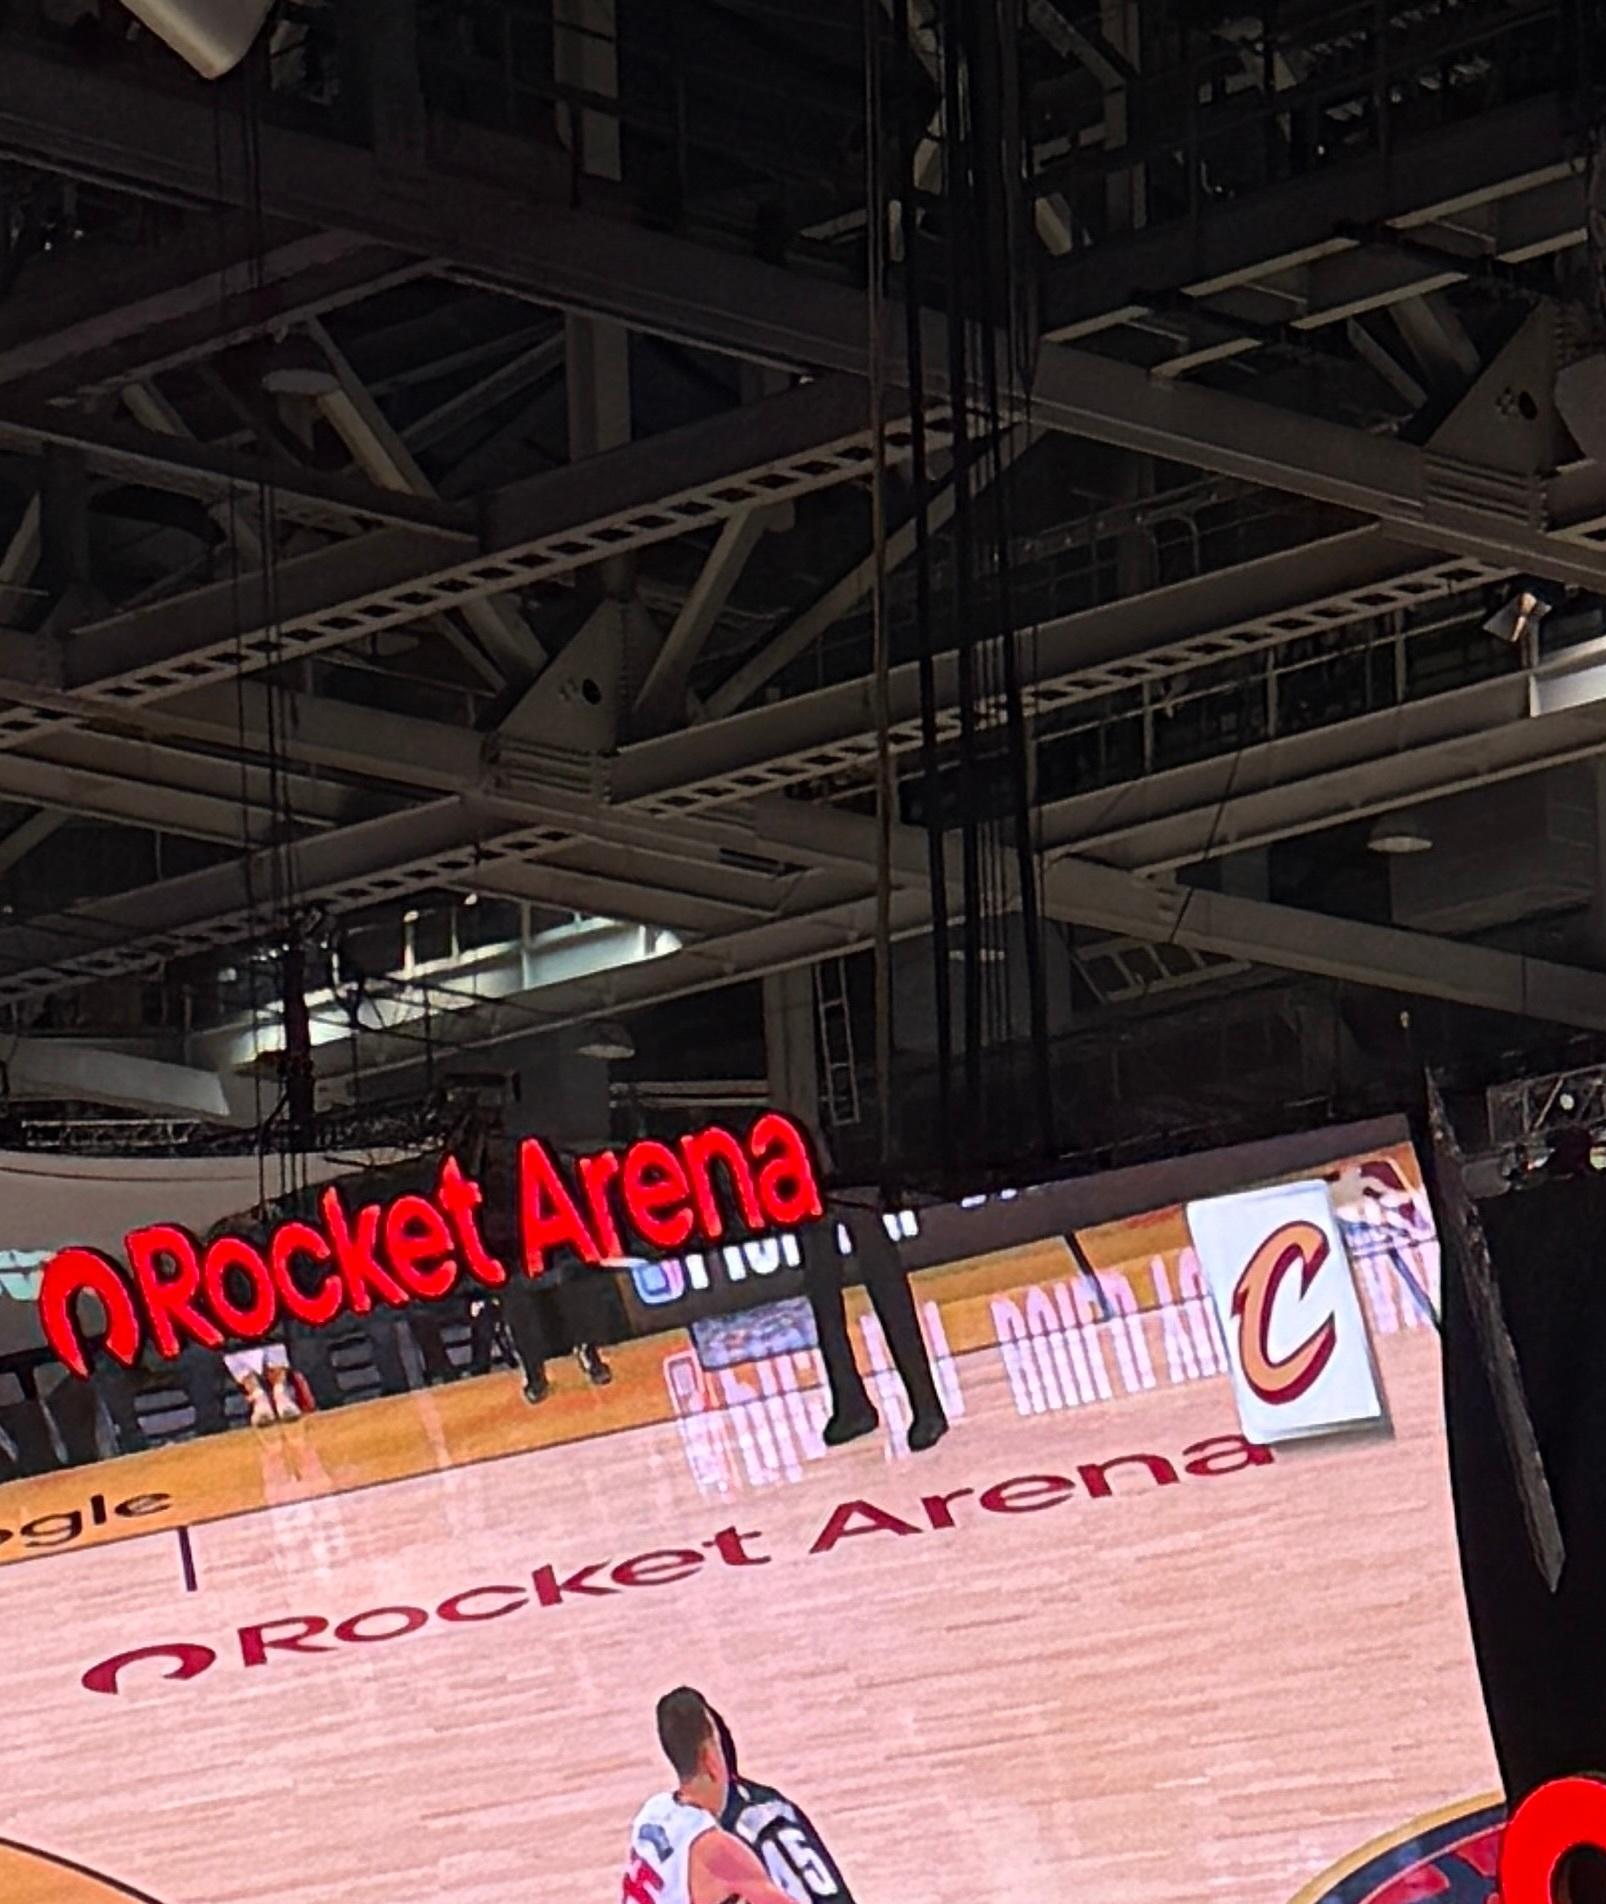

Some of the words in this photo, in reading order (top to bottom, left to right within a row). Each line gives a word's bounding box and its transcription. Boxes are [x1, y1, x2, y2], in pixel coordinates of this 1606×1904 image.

[127, 1155, 507, 1358] Rocket
[519, 1113, 822, 1279] Arena
[0, 1493, 171, 1547] gle
[239, 1526, 771, 1667] Rocket
[810, 1434, 1274, 1555] Arena
